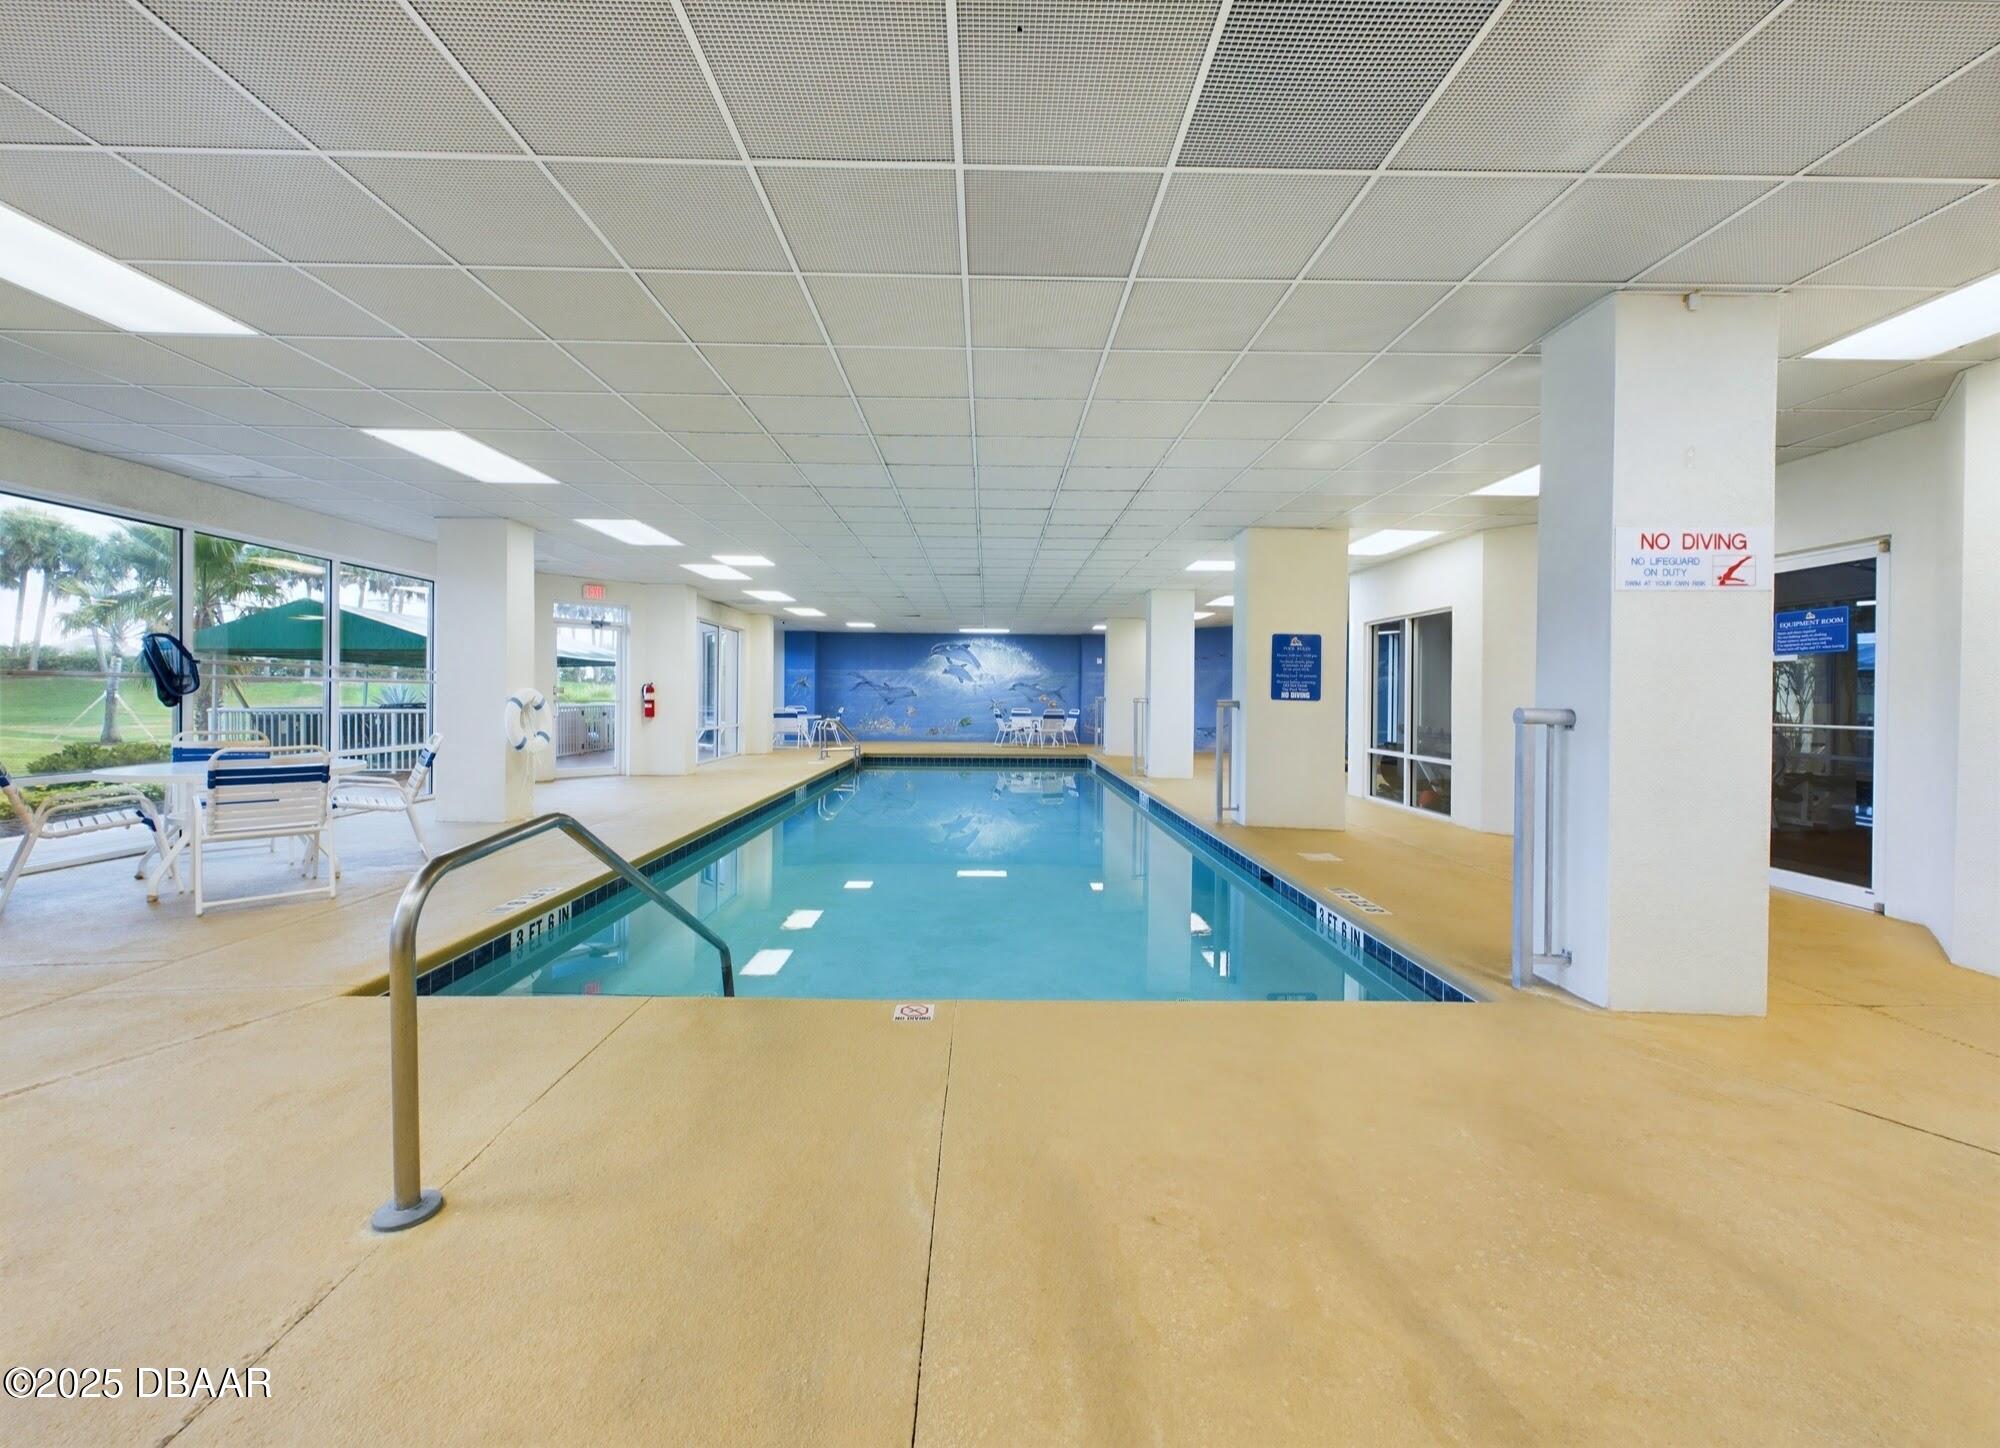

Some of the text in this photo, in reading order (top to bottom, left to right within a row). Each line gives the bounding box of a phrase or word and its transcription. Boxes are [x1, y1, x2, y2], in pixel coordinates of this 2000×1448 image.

[1641, 533, 1747, 550] NO DIVING
[1631, 557, 1700, 566] NO LIFEGUARD
[1643, 568, 1687, 577] ON DUTY
[1779, 617, 1844, 629] EQUIPMENT ROOM
[1281, 691, 1310, 699] NO DIVING
[517, 905, 569, 947] 3 FT 6 IN
[1319, 907, 1361, 947] 3 FT 6 IN
